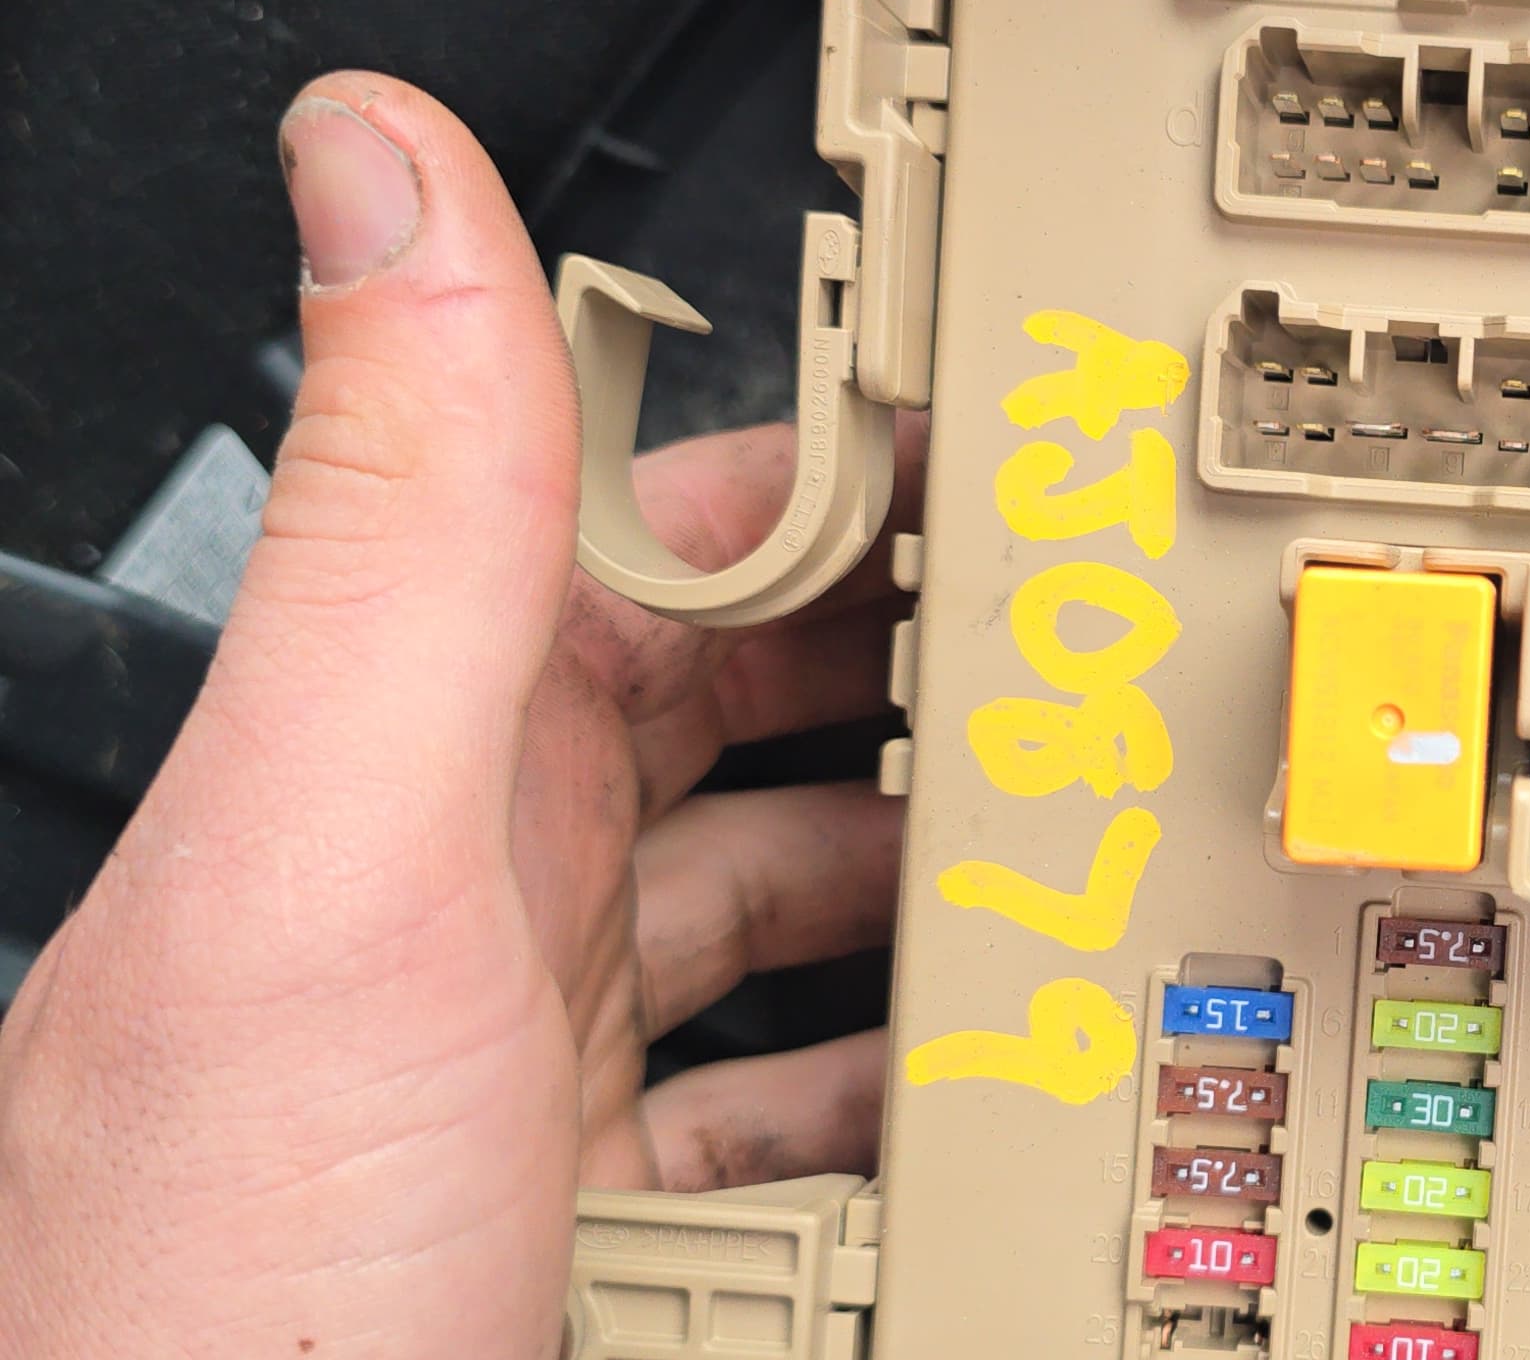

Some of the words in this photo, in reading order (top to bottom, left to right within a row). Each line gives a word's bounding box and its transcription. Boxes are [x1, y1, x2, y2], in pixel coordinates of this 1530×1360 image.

[1165, 86, 1202, 148] d
[1334, 927, 1342, 955] 1
[1418, 929, 1467, 961] 7.5
[1206, 998, 1249, 1030] 15
[1322, 1009, 1344, 1036] 6
[1414, 1012, 1458, 1042] 20
[1198, 1079, 1244, 1111] 7.5
[1315, 1087, 1339, 1115] 11
[1411, 1094, 1453, 1126] 30
[1101, 1156, 1128, 1184] 15
[1192, 1159, 1241, 1192] 7.5
[1306, 1170, 1335, 1199] 16
[1403, 1176, 1448, 1206] 20
[1091, 1233, 1121, 1264] 20
[1188, 1239, 1232, 1272] 10
[1303, 1249, 1332, 1277] 21
[1397, 1256, 1441, 1288] 20
[1085, 1317, 1118, 1345] 25
[1297, 1332, 1325, 1358] 26
